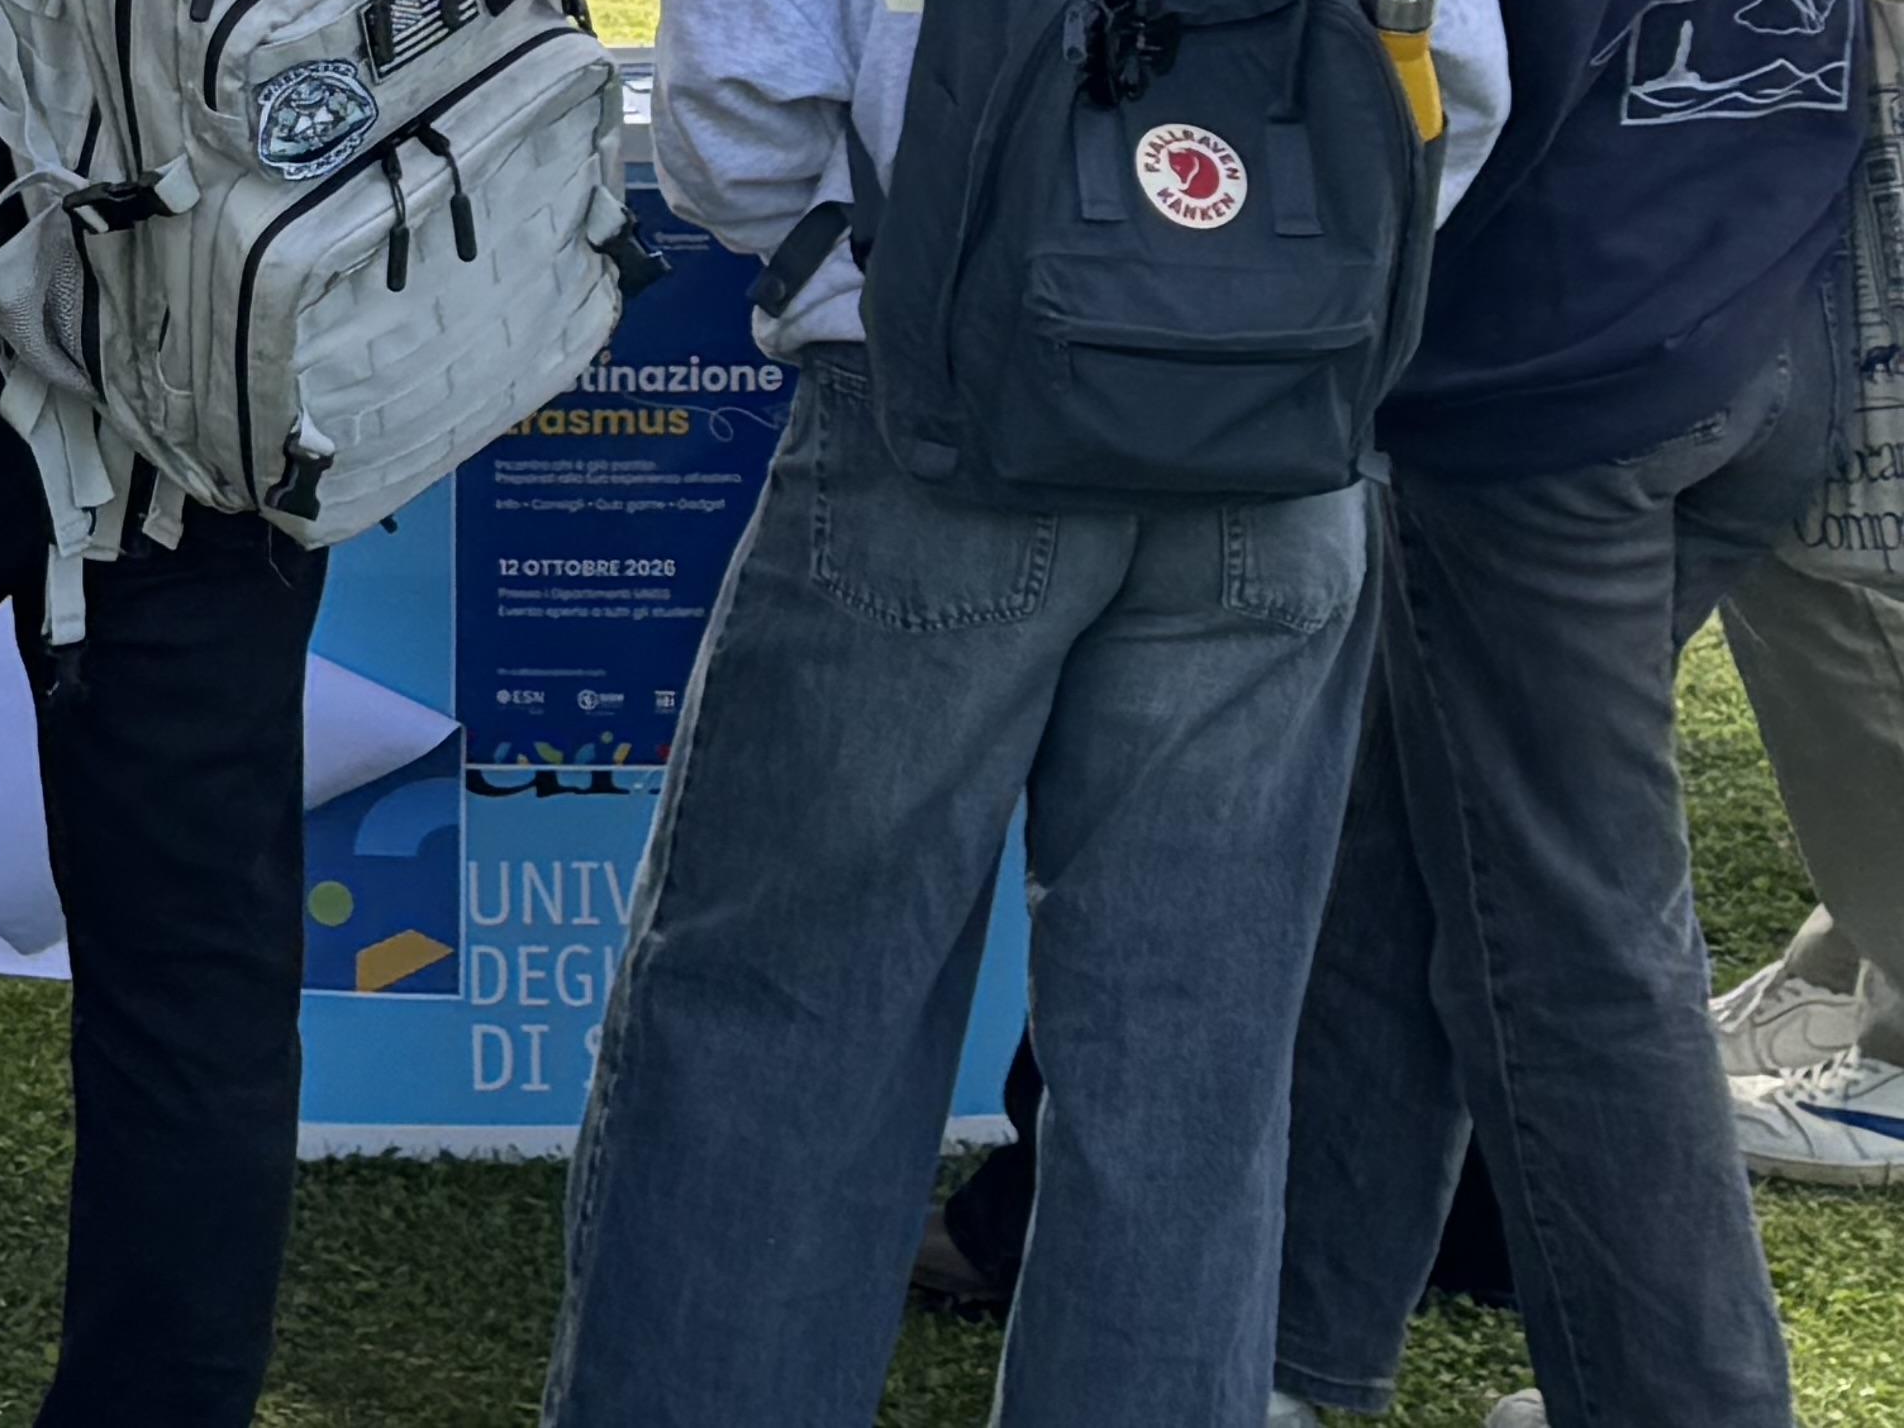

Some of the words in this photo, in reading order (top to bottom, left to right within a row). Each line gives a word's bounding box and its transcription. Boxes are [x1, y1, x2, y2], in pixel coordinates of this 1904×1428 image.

[562, 355, 783, 393] tinazione
[504, 408, 689, 435] rasmus
[499, 559, 518, 575] 12
[522, 559, 620, 576] OTTOBRE
[624, 559, 676, 576] 2026
[472, 1024, 550, 1092] DI
